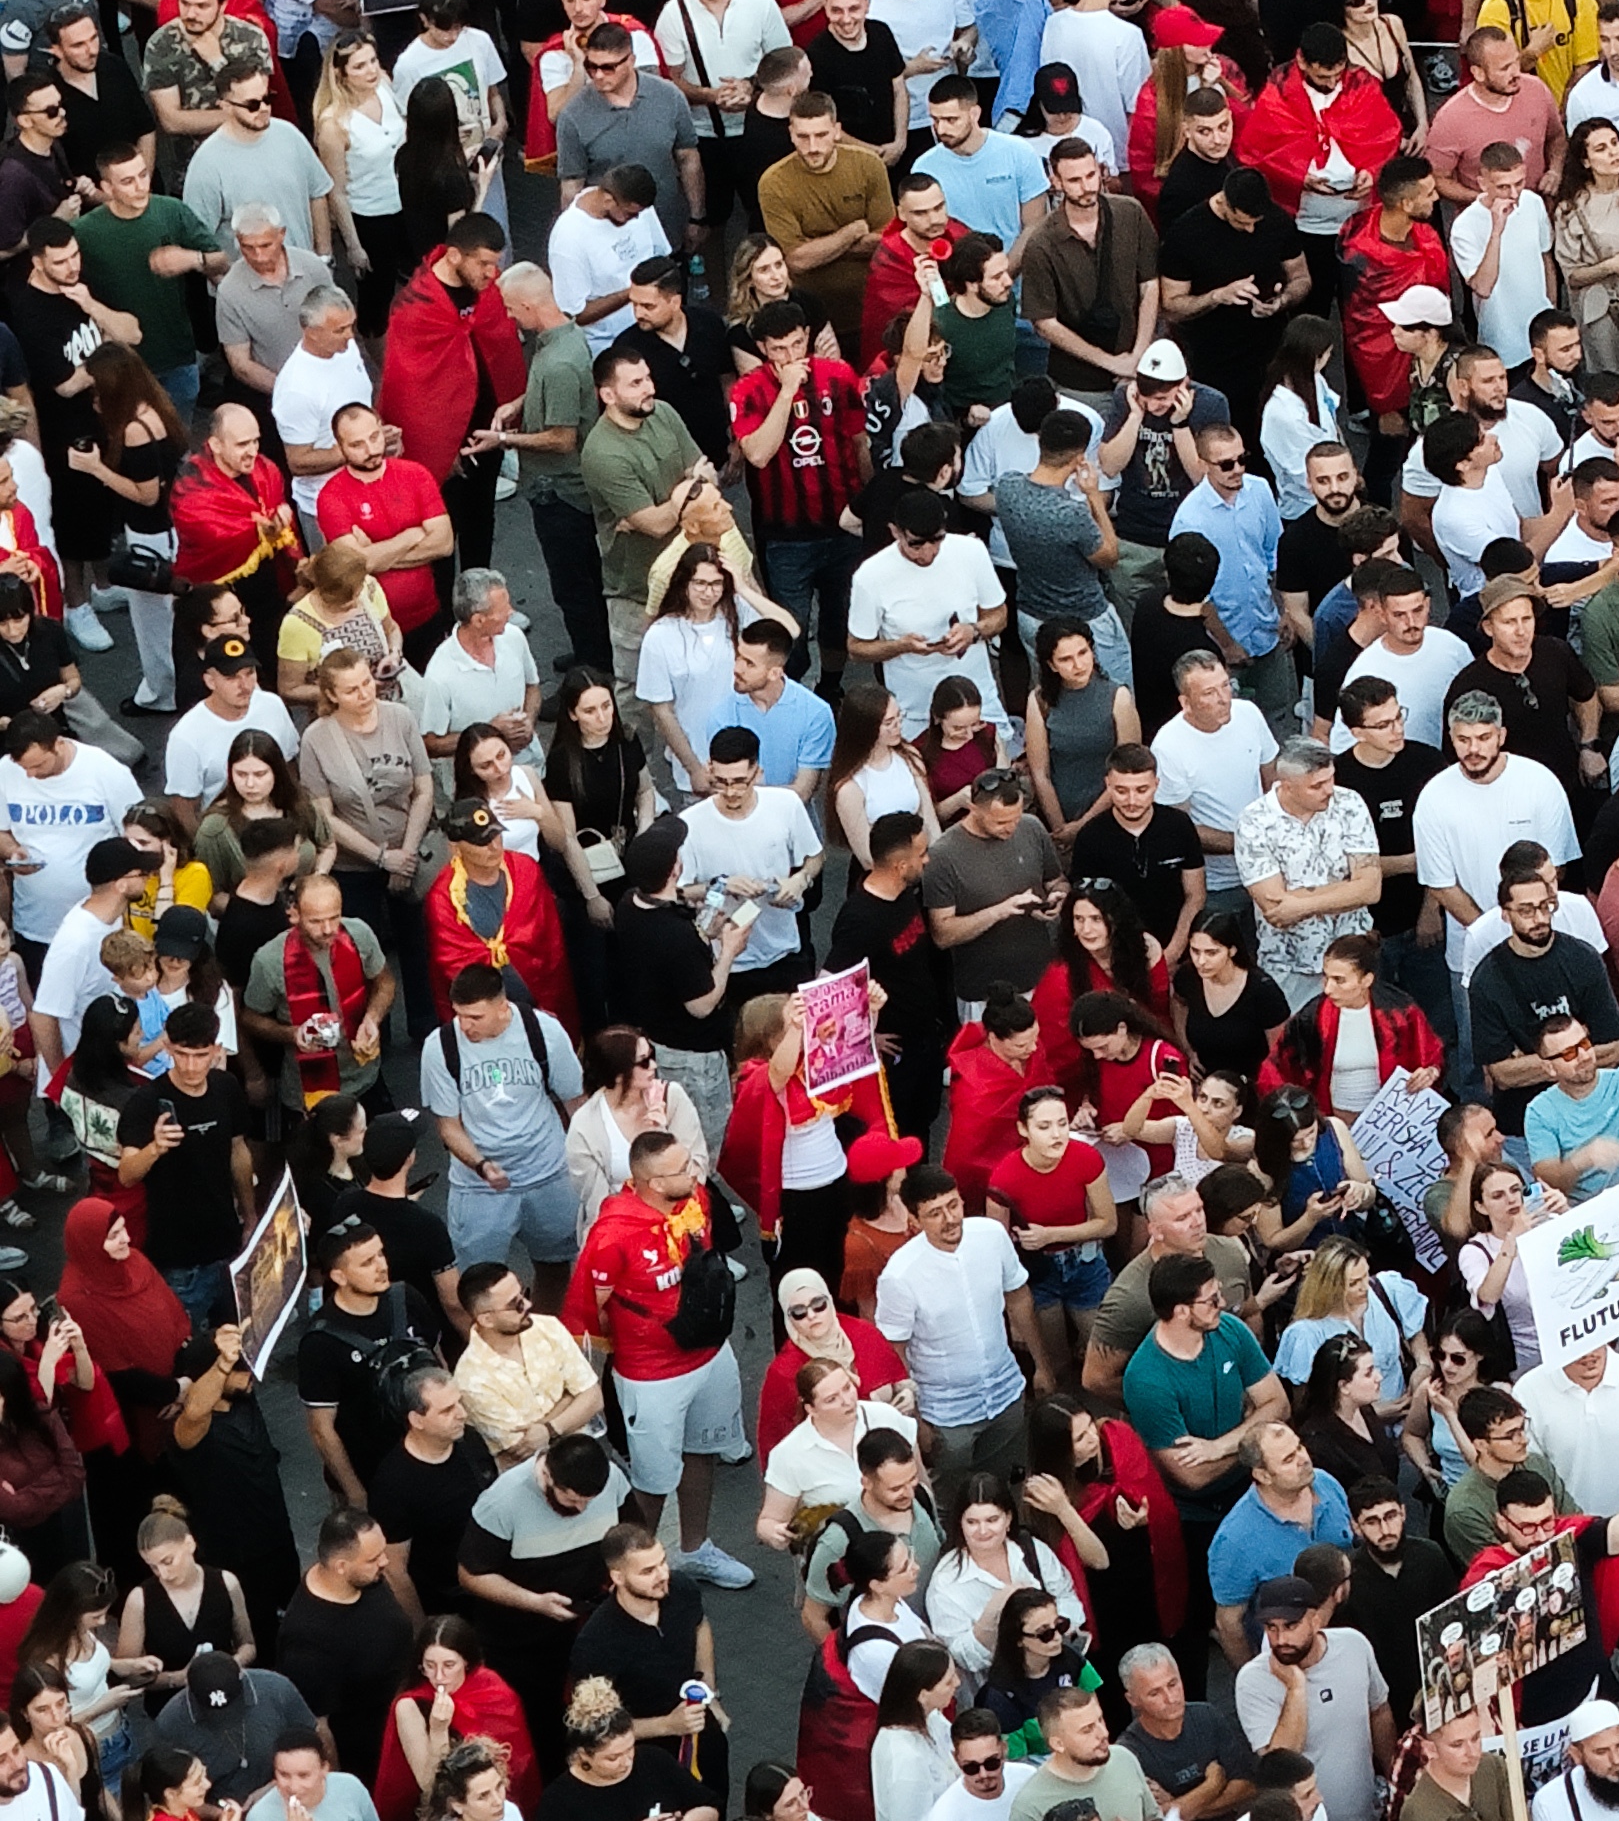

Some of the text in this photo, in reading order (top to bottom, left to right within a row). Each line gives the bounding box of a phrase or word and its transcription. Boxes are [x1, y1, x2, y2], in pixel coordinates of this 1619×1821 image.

[793, 455, 826, 468] OPEL
[463, 1058, 542, 1096] JORDAN
[1363, 1100, 1434, 1161] BERISHA
